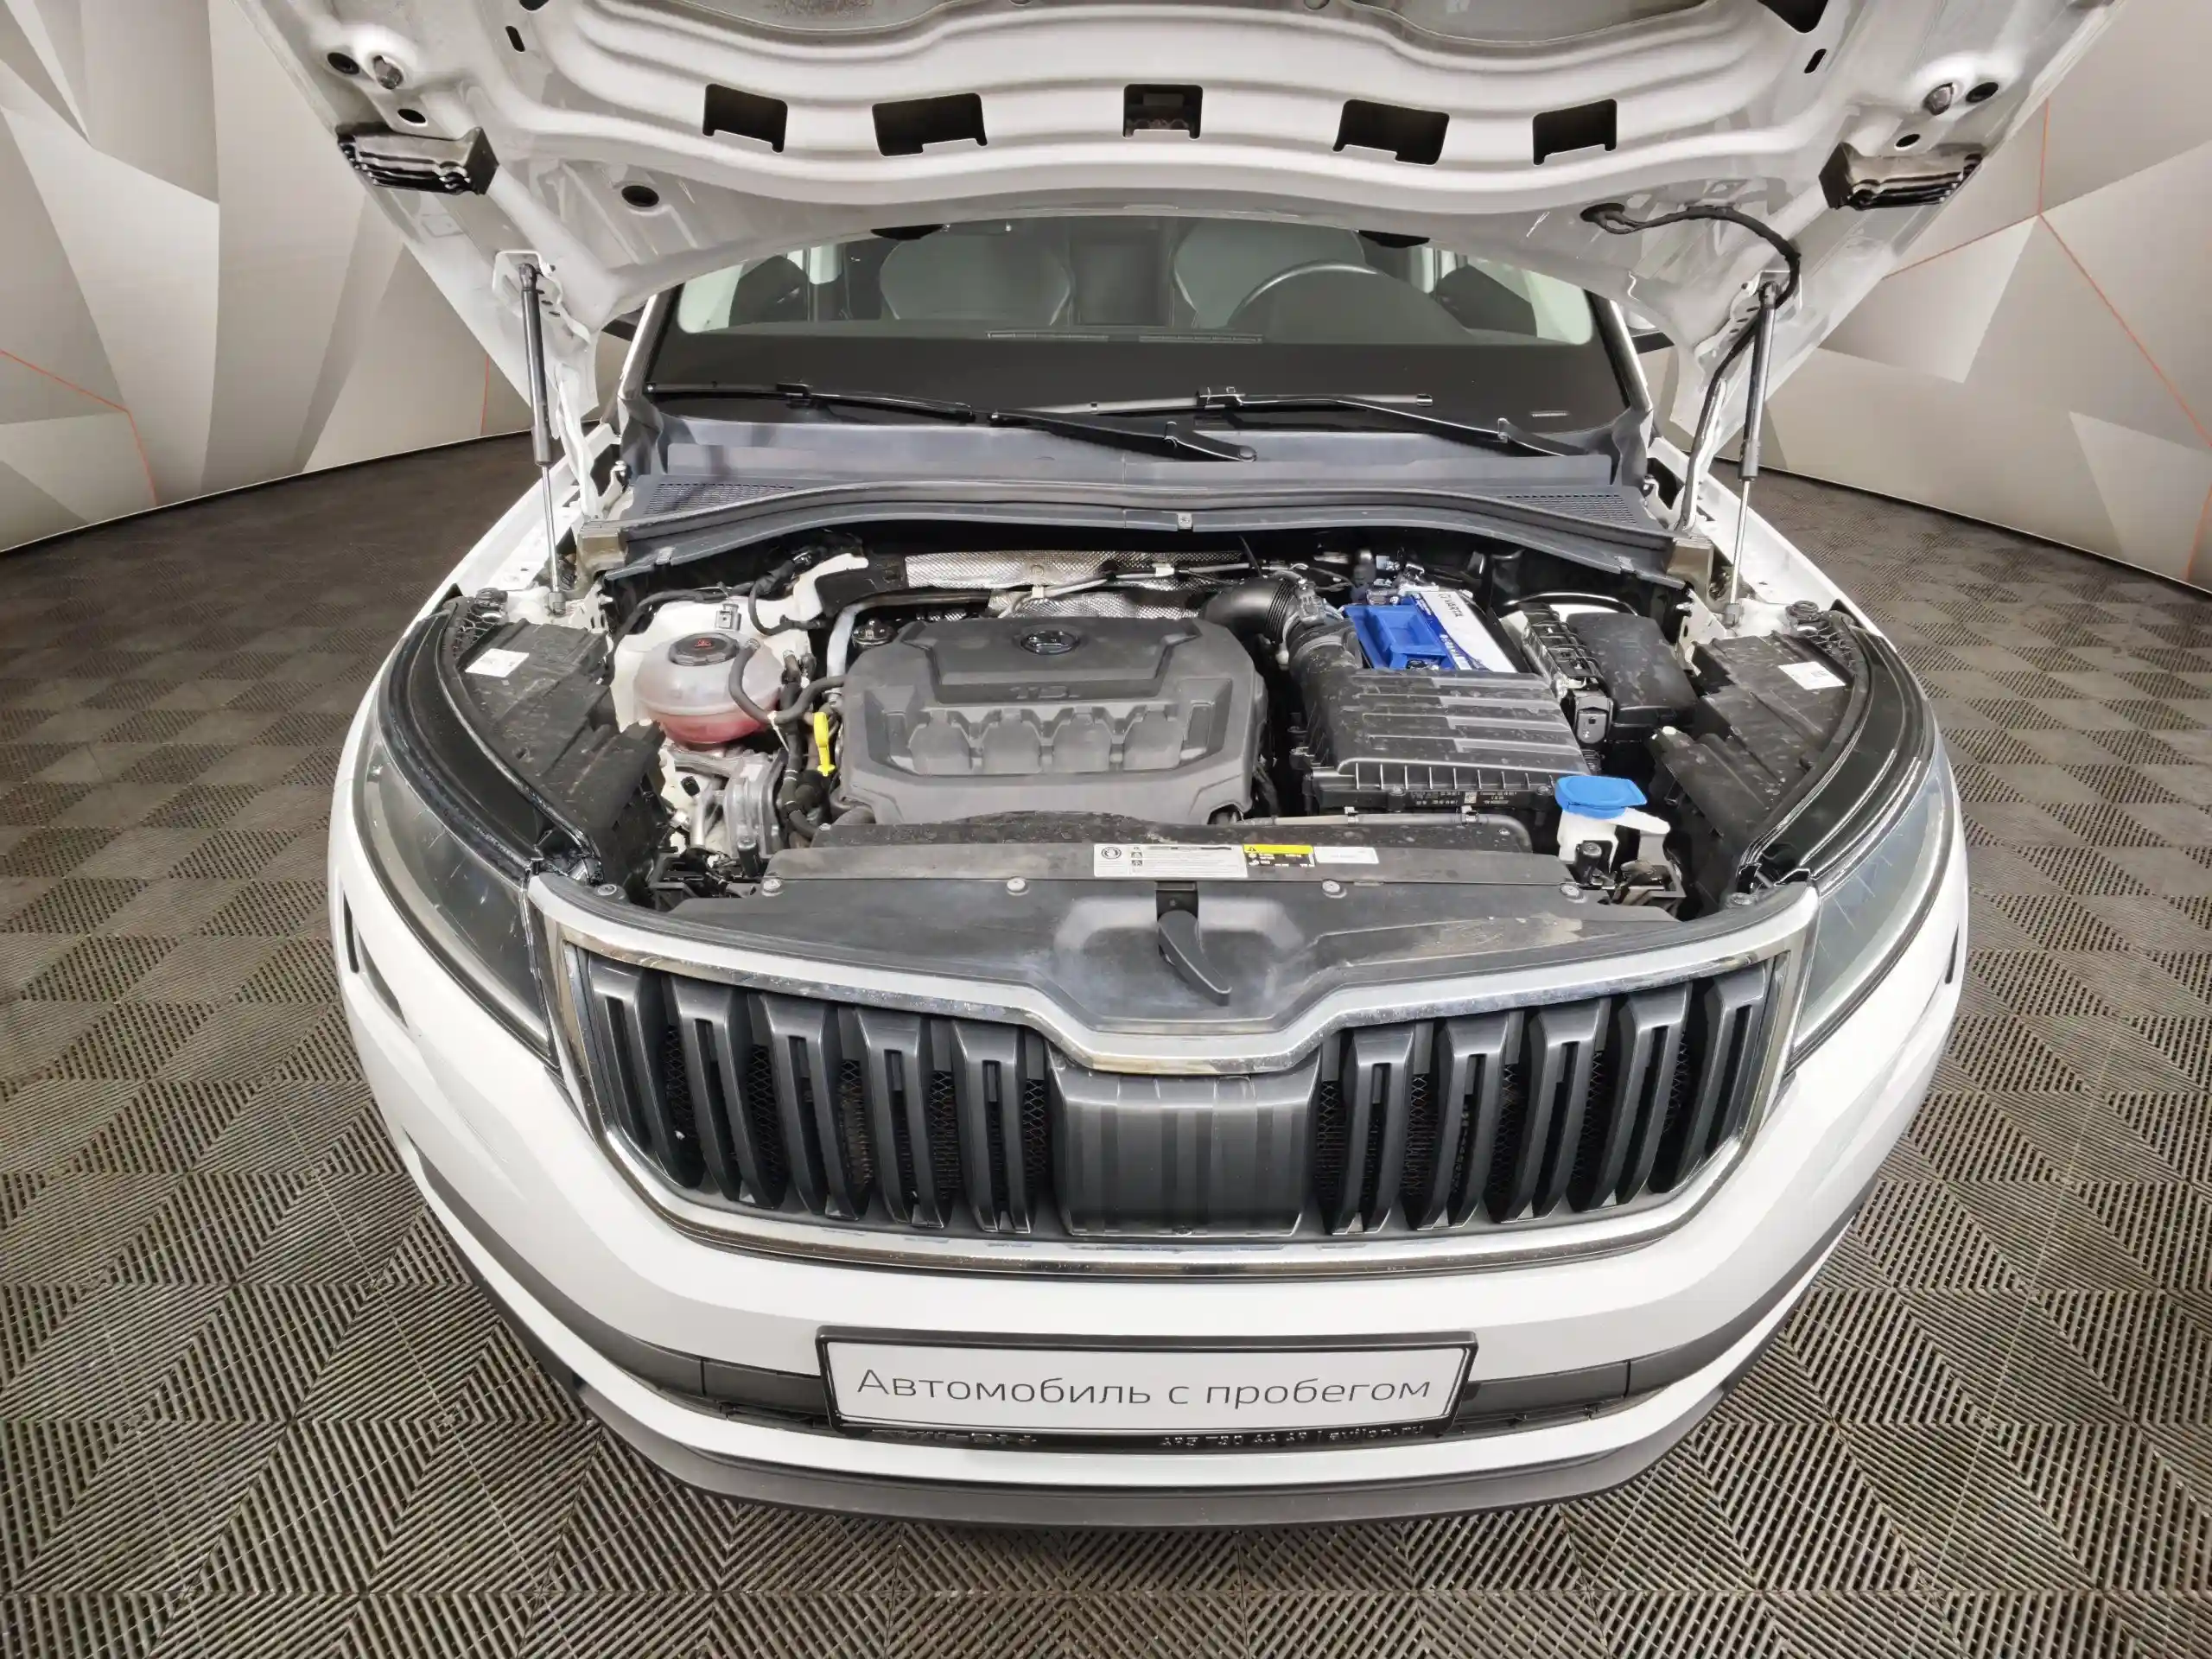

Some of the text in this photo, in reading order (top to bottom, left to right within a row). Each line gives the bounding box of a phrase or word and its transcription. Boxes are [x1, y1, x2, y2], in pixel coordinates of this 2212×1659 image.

[857, 1369, 1431, 1409] Автомобиль с пробегом
